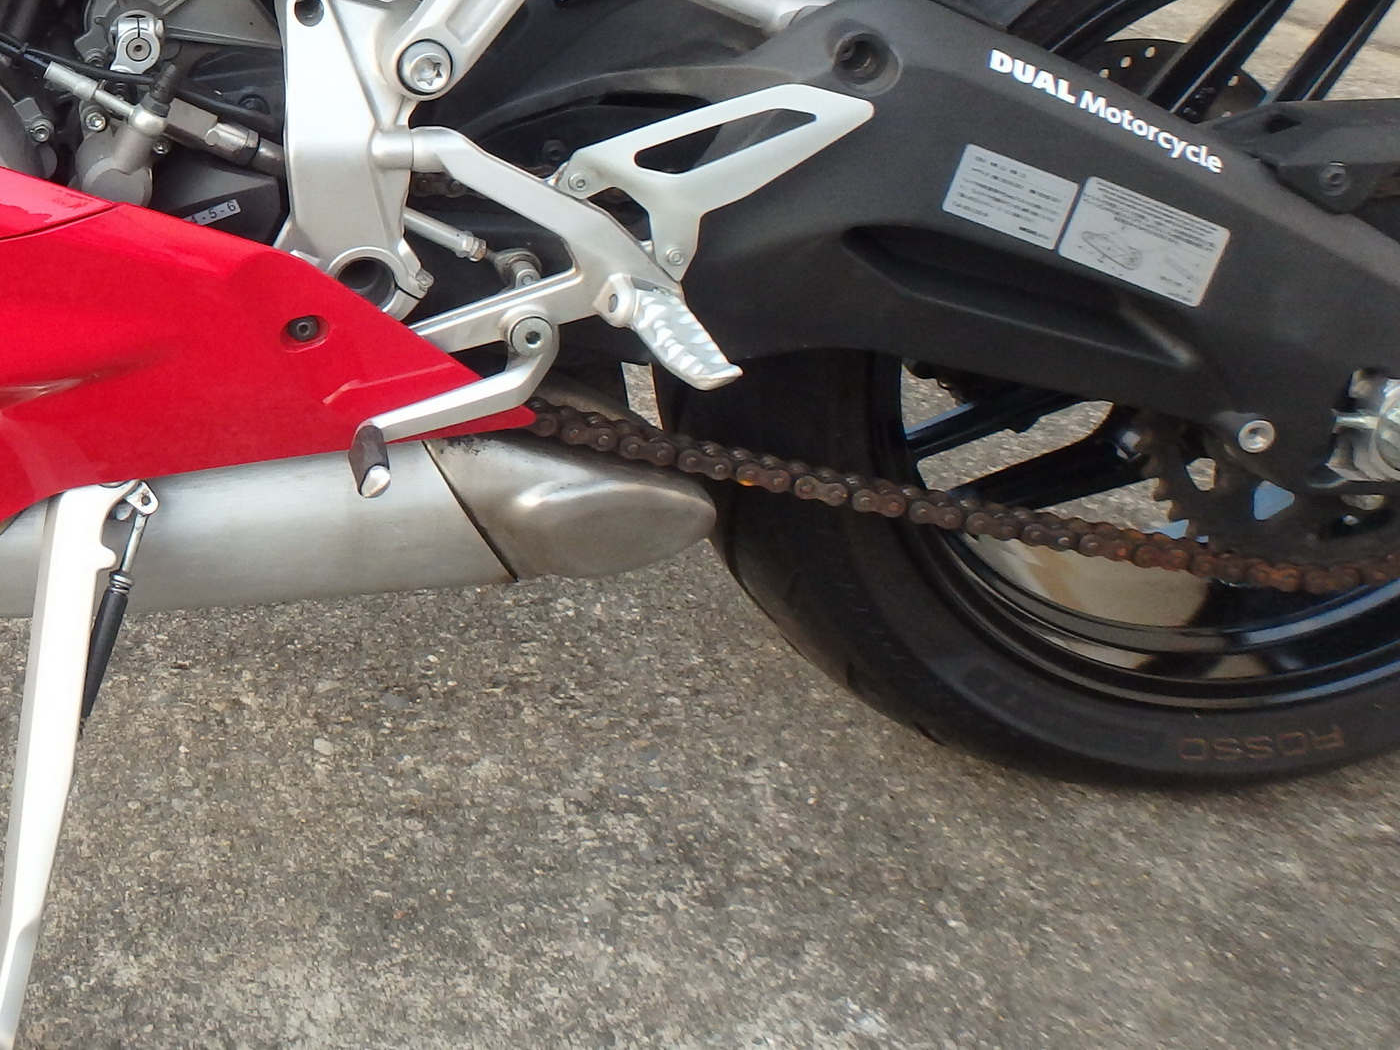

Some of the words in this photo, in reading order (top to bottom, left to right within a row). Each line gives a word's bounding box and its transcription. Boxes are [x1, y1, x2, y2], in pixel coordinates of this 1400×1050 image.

[989, 48, 1077, 104] DUAL
[1079, 90, 1224, 174] Motorcycle
[1178, 724, 1346, 761] ROSSO
